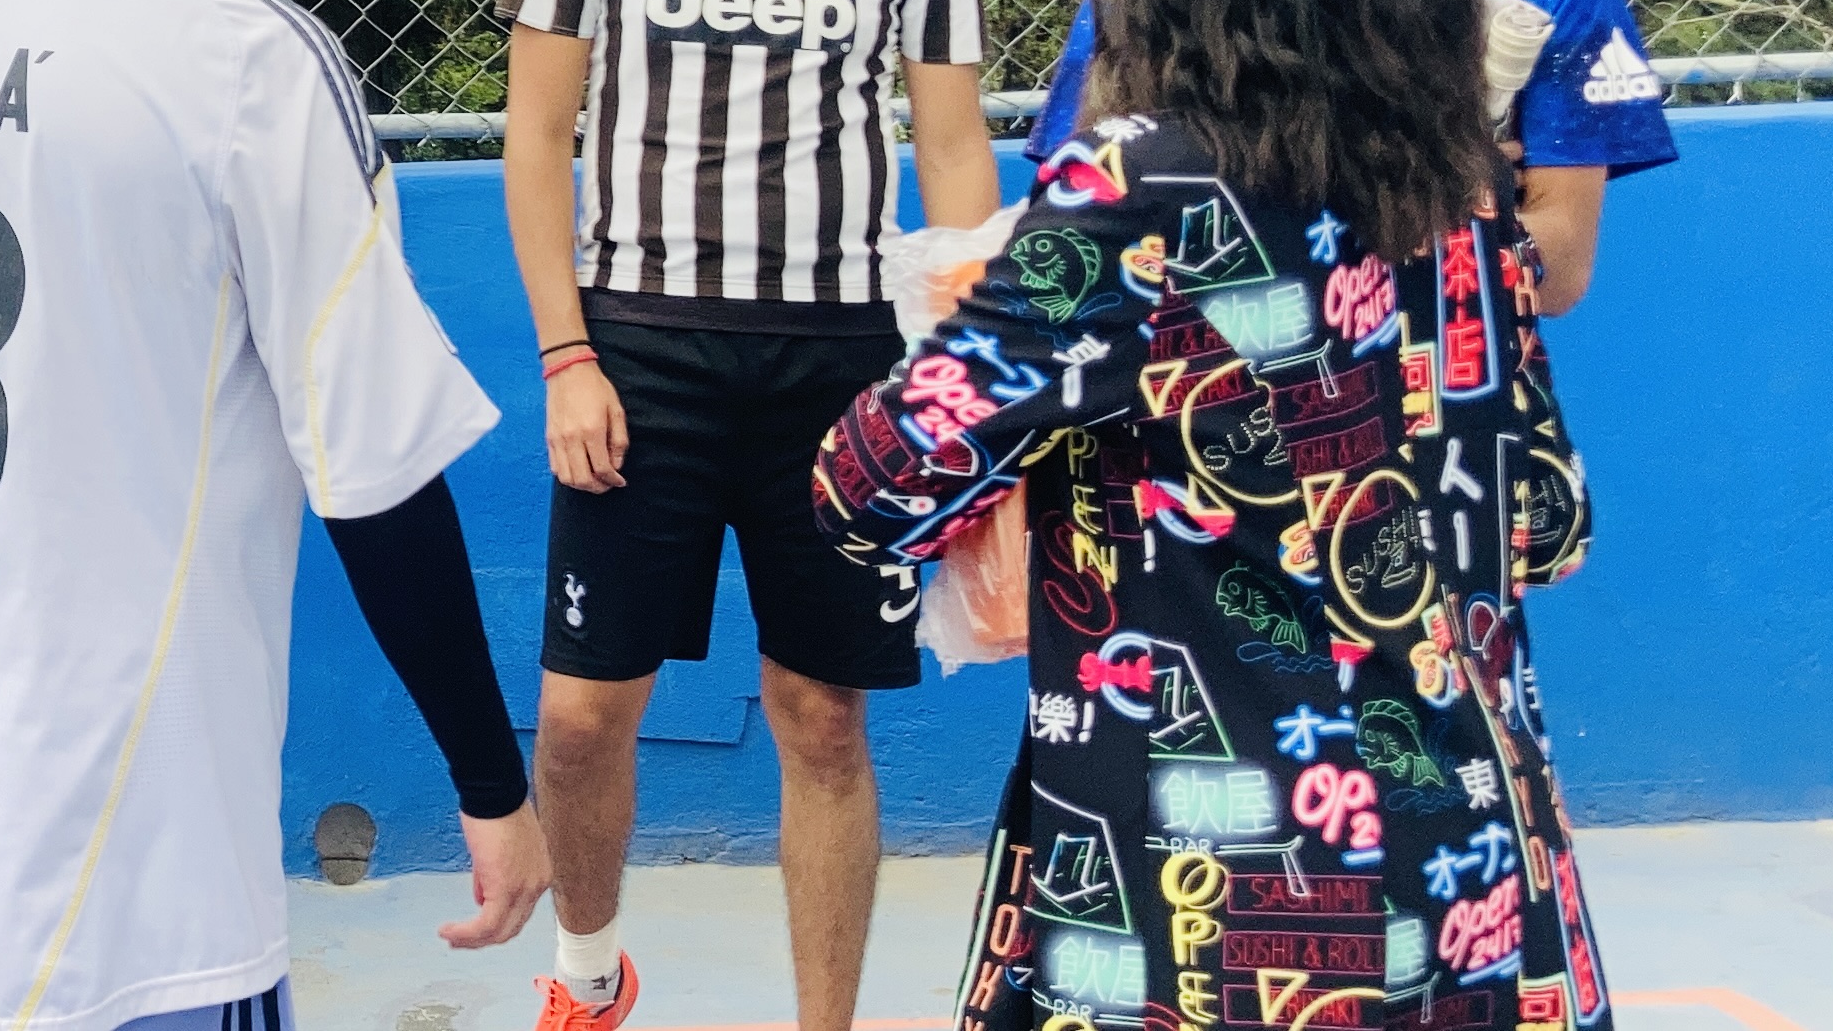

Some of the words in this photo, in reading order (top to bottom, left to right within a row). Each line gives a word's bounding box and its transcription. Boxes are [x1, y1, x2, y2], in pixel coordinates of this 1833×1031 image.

[1455, 758, 1501, 810] 東
[1160, 769, 1278, 835] 飲屋
[1169, 837, 1211, 856] BAR
[1249, 877, 1372, 911] SASHIMI
[1227, 935, 1295, 967] SUSHI
[1303, 935, 1322, 968] &
